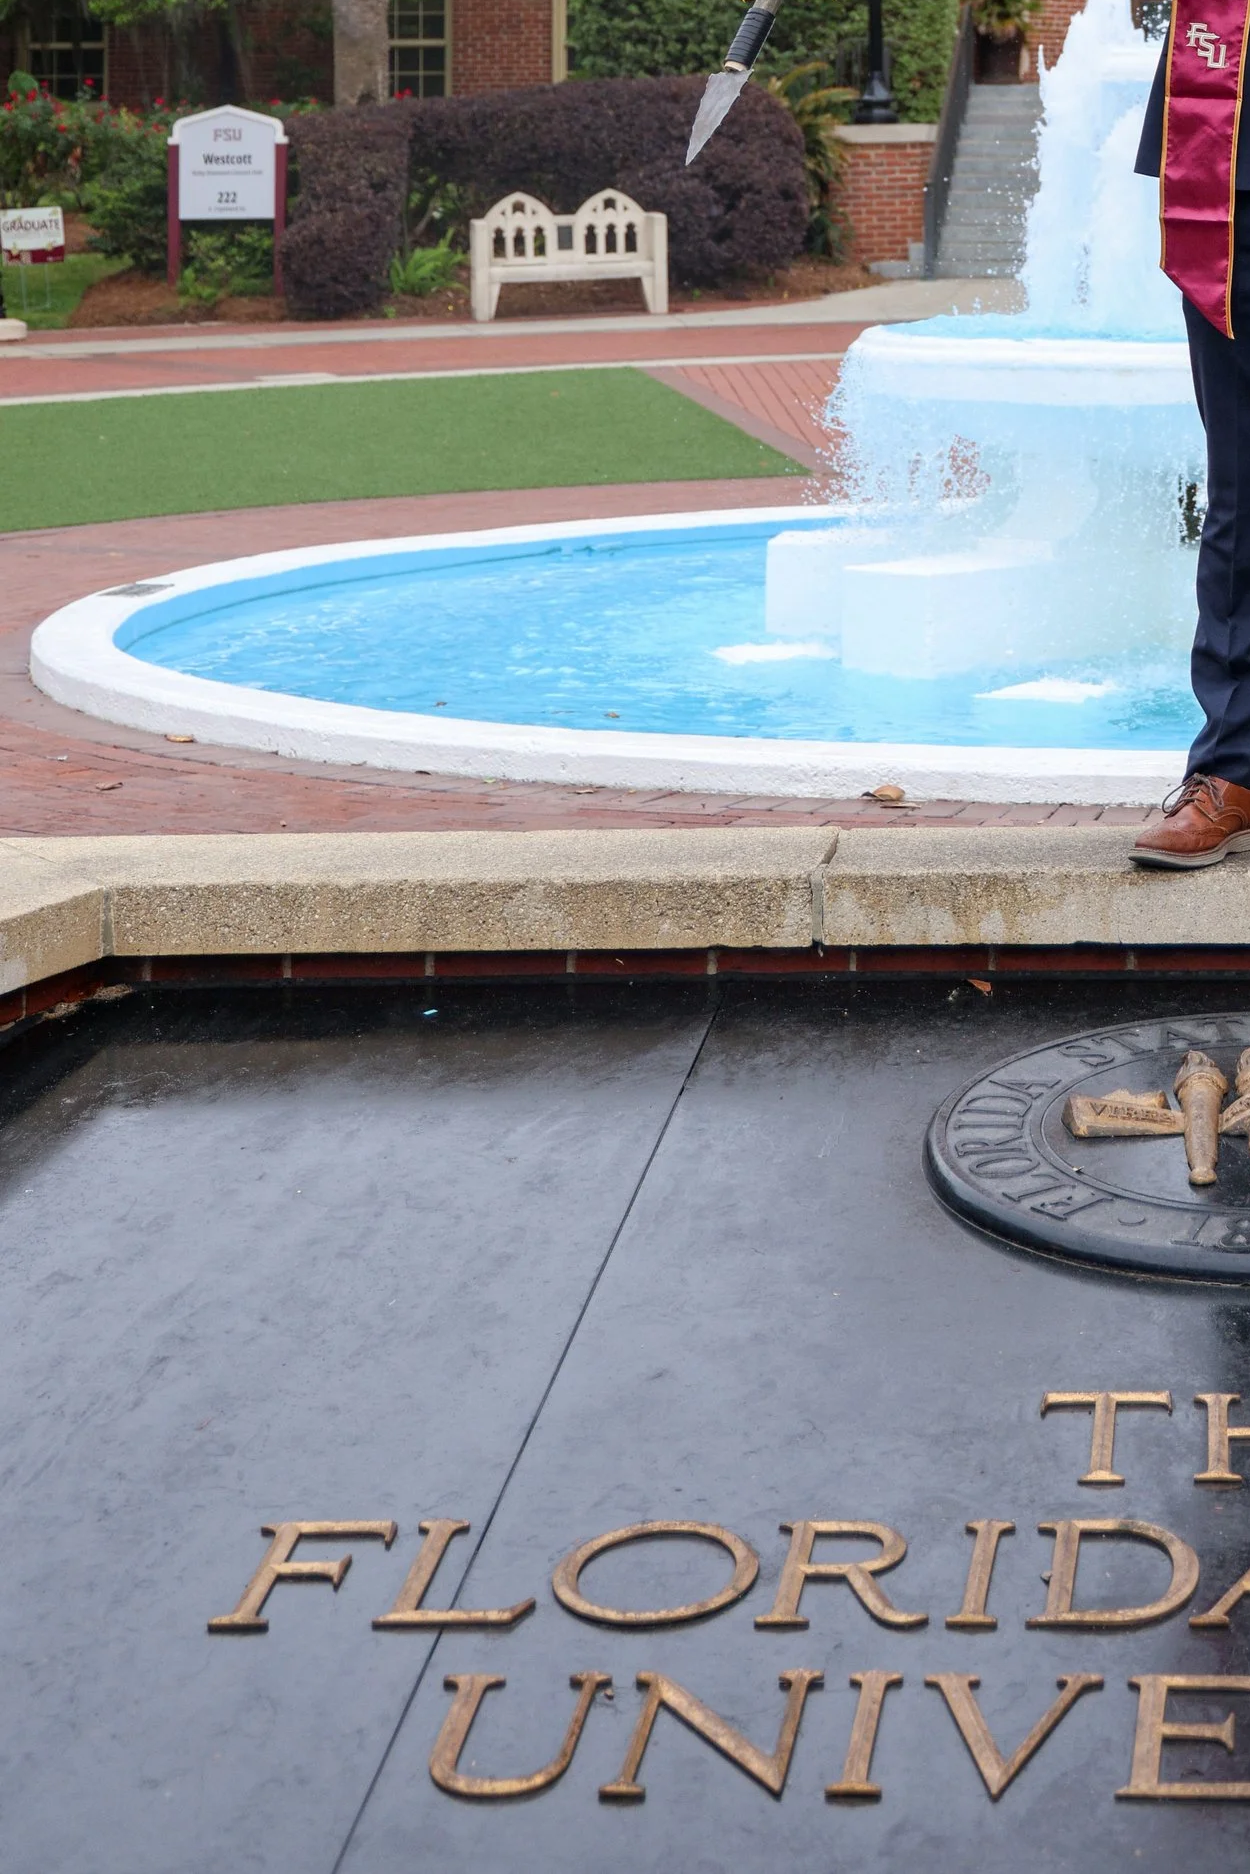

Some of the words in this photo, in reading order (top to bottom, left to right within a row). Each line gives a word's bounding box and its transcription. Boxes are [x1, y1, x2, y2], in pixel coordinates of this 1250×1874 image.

[1185, 22, 1227, 69] FSU
[213, 128, 242, 142] FSU
[203, 153, 253, 165] Westcott
[217, 191, 238, 203] 222
[2, 219, 60, 233] GRADUATE
[953, 1078, 1114, 1222] FLORIDA
